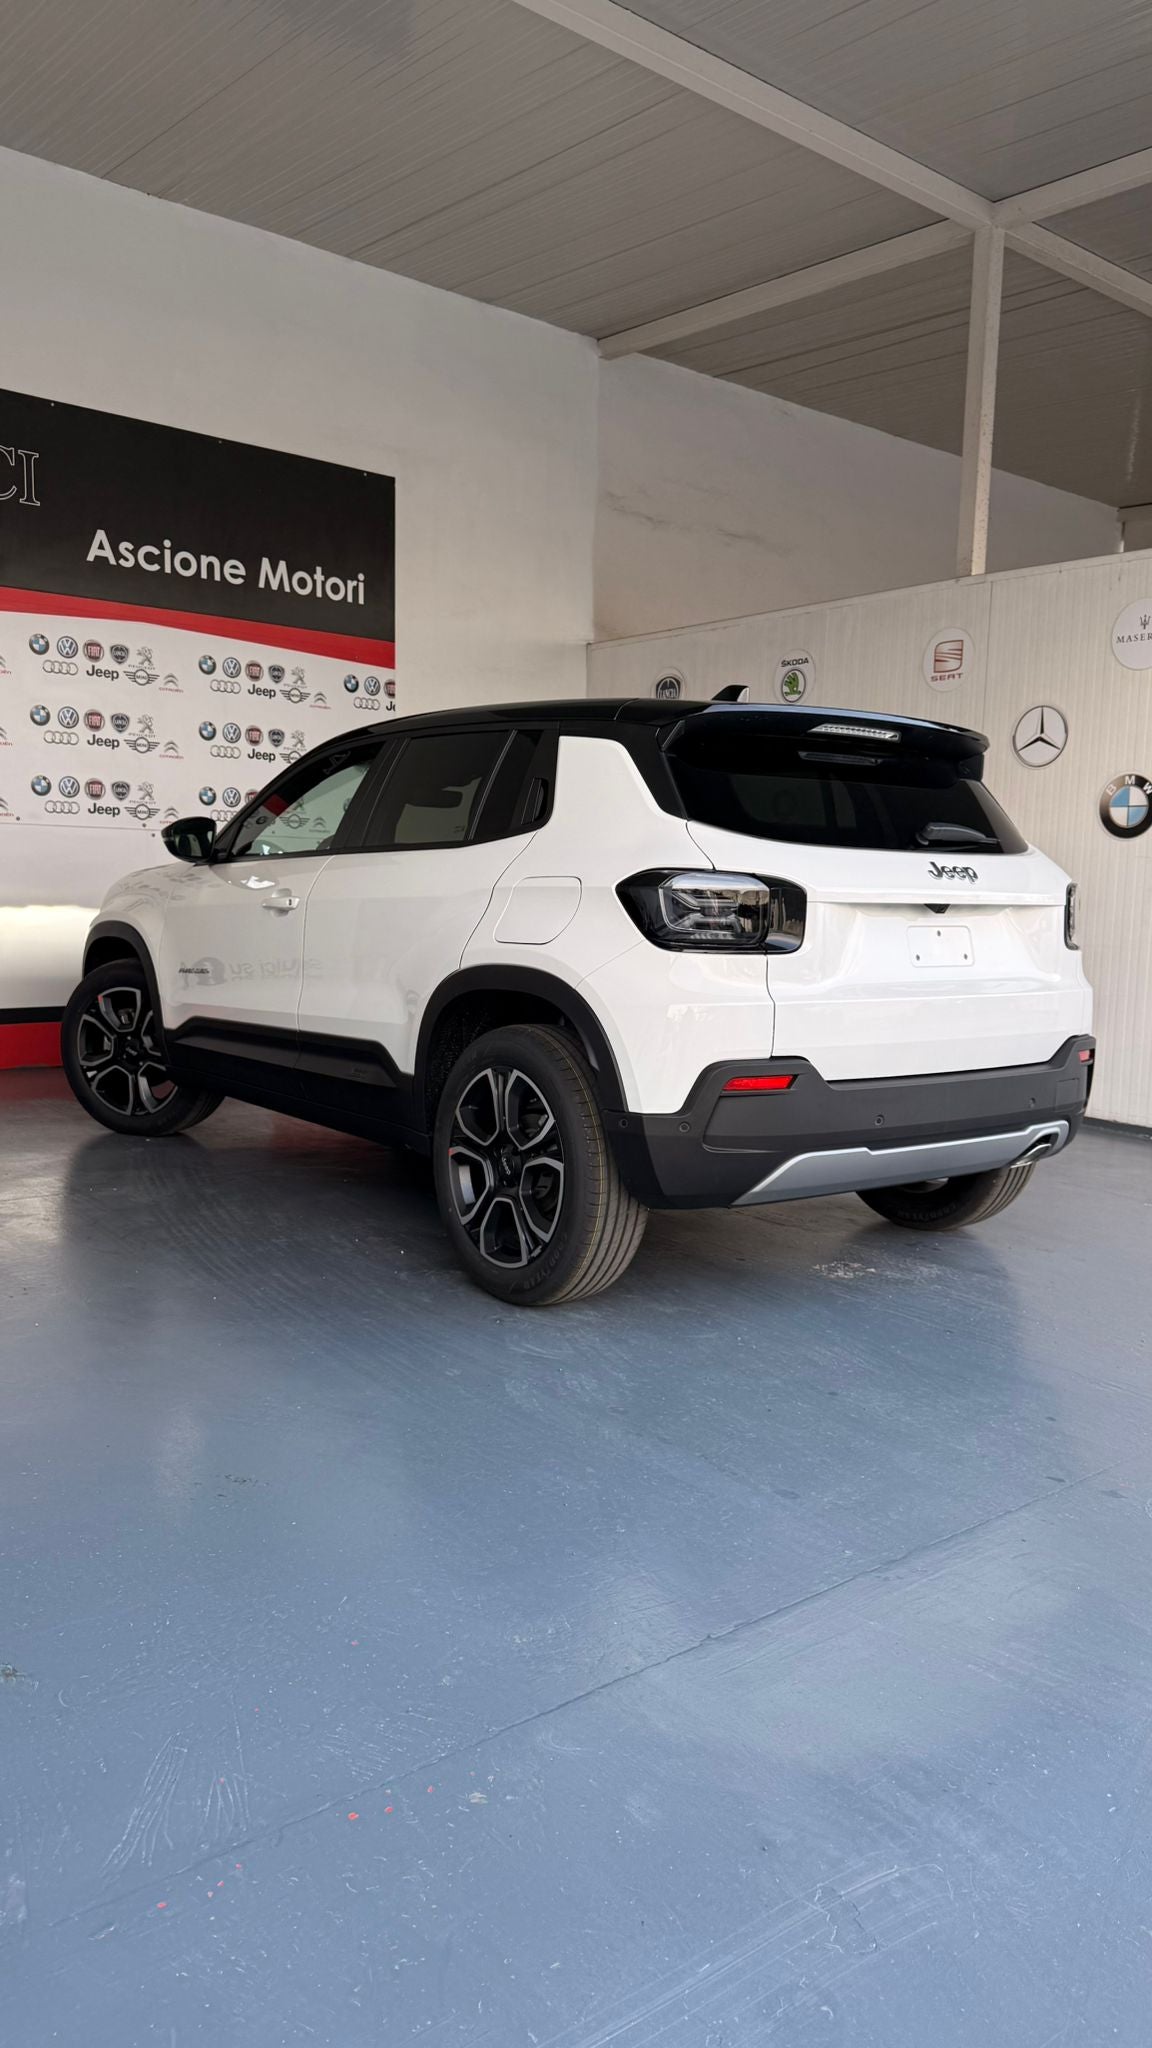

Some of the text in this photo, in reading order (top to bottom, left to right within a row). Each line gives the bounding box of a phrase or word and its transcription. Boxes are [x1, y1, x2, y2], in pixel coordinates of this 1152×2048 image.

[86, 529, 364, 605] Ascione Motori
[86, 664, 119, 681] Jeep
[930, 672, 963, 682] SEAT
[248, 683, 276, 699] Jeep
[87, 734, 120, 750] Jeep
[248, 748, 276, 763] Jeep
[88, 802, 120, 818] Jeep
[928, 861, 978, 885] Jeep
